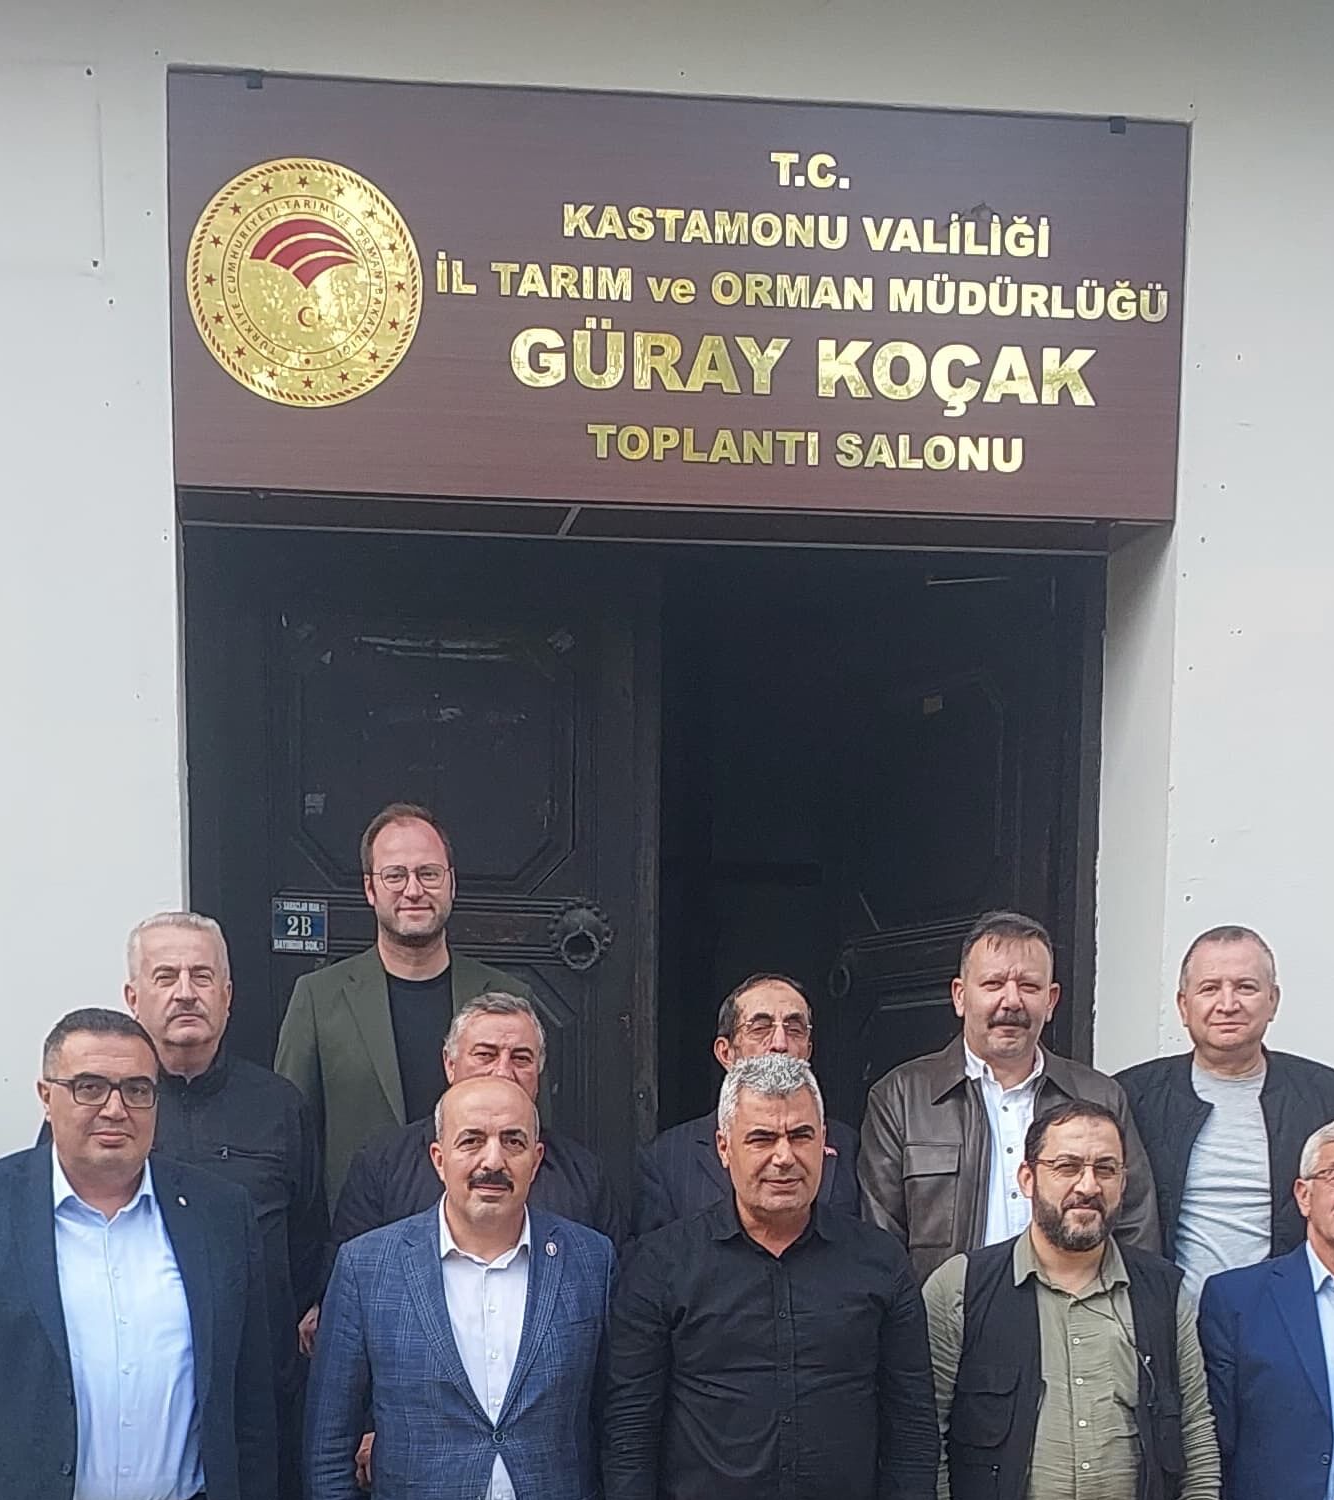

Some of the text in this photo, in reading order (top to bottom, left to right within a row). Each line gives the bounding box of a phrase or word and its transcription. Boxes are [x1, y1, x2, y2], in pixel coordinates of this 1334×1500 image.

[770, 152, 850, 189] T.C.
[284, 199, 330, 213] TARIM
[336, 211, 351, 227] VE
[355, 228, 384, 281] ORMAN
[563, 203, 1050, 258] KASTAMONU VALİLİĞİ
[436, 251, 1168, 323] İL TARIM ve ORMAN MÜDÜRLÜĞÜ
[510, 317, 1097, 417] GÜRAY KOÇAK
[587, 424, 1024, 473] TOPLANTI SALONU
[287, 915, 312, 937] 2B
